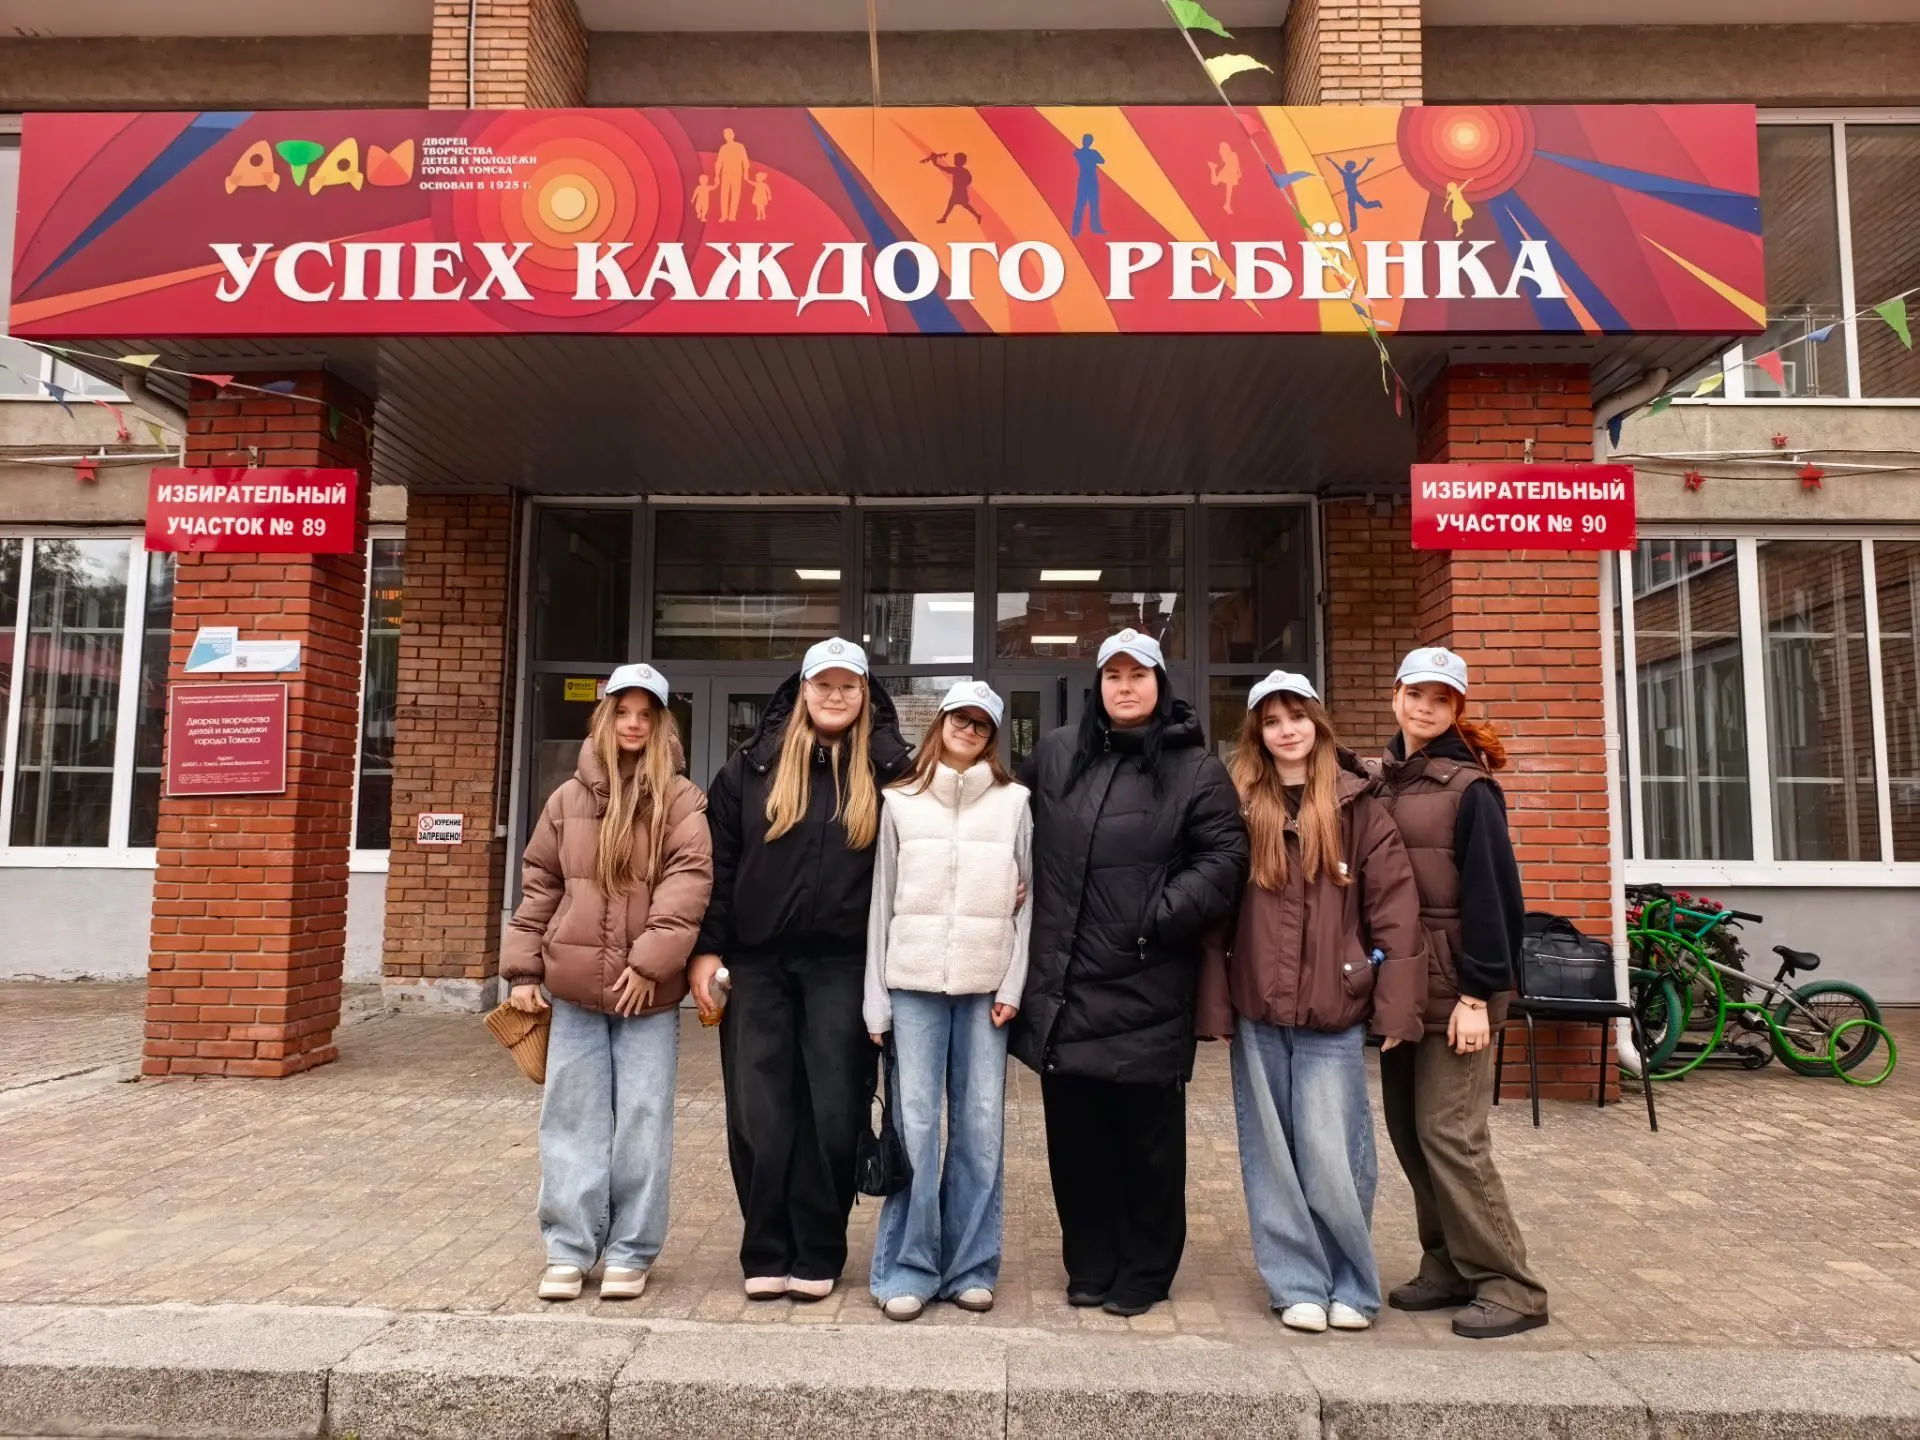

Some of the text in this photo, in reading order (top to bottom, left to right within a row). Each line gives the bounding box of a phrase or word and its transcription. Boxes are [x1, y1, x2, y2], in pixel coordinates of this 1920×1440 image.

[422, 137, 468, 146] ДВОРЕЦ
[422, 146, 493, 155] ТВОРЧЕСТВА
[421, 155, 457, 165] ДЕТЕЙ
[461, 156, 469, 164] И
[422, 166, 513, 175] ГОРОДА ТОМСКА
[419, 181, 473, 190] ОСНОВАН
[477, 181, 485, 189] В
[490, 181, 519, 189] 1925
[208, 221, 1568, 317] УСПЕХ КАЖДОГО РЕБЁНКА
[157, 483, 347, 504] ИЗБИРАТЕЛЬНЫЙ
[1422, 478, 1625, 500] ИЗБИРАТЕЛЬНЫЙ
[167, 517, 326, 536] УЧАСТОК № 89
[1436, 514, 1607, 533] УЧАСТОК № 90
[185, 716, 270, 726] Дворец творчества
[188, 726, 214, 736] детей
[194, 735, 261, 746] города Томска
[418, 831, 461, 842] ЗАПРЕЩЕНО!
